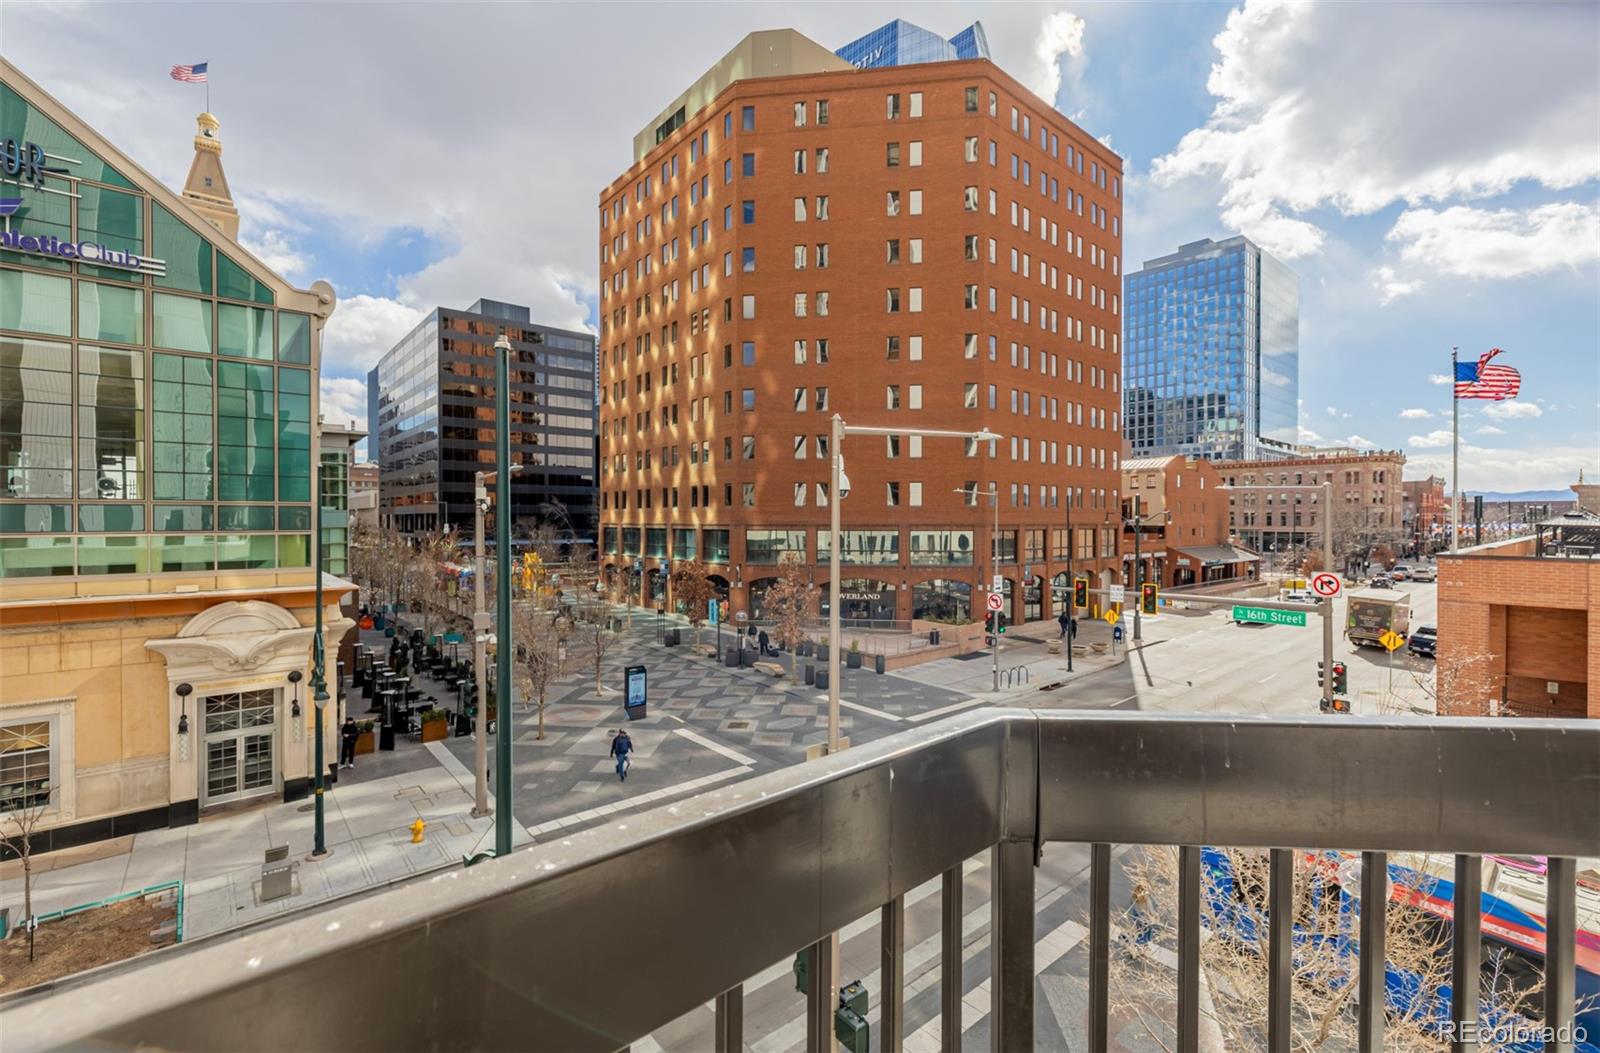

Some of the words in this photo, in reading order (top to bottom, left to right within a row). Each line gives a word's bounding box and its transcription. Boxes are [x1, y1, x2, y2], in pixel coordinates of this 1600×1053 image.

[839, 592, 881, 600] VERLAND
[1247, 609, 1267, 621] 16th
[1270, 611, 1302, 624] Street
